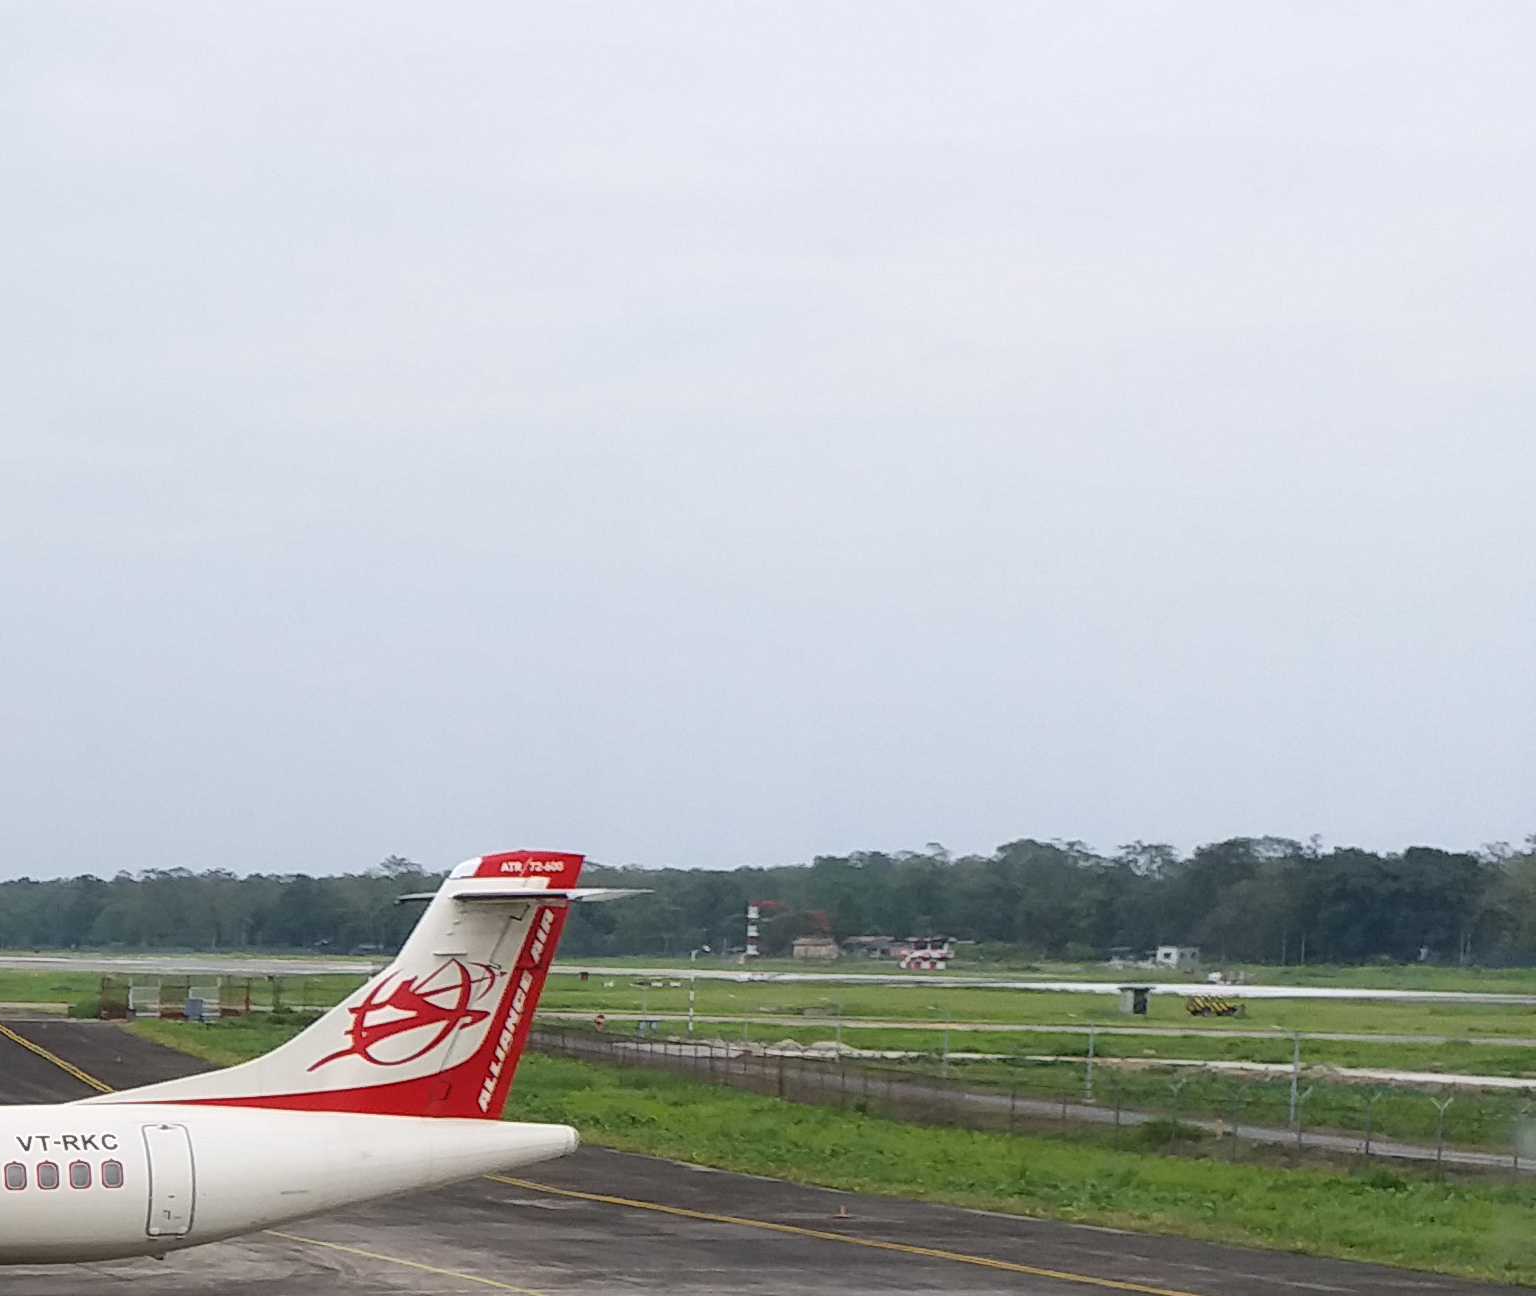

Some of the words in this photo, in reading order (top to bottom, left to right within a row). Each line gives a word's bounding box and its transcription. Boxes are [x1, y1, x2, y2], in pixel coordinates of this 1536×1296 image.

[501, 860, 523, 873] ATR
[478, 968, 534, 1113] ALLIANCE
[530, 908, 555, 965] AIR
[15, 1133, 119, 1152] VT-RKC
